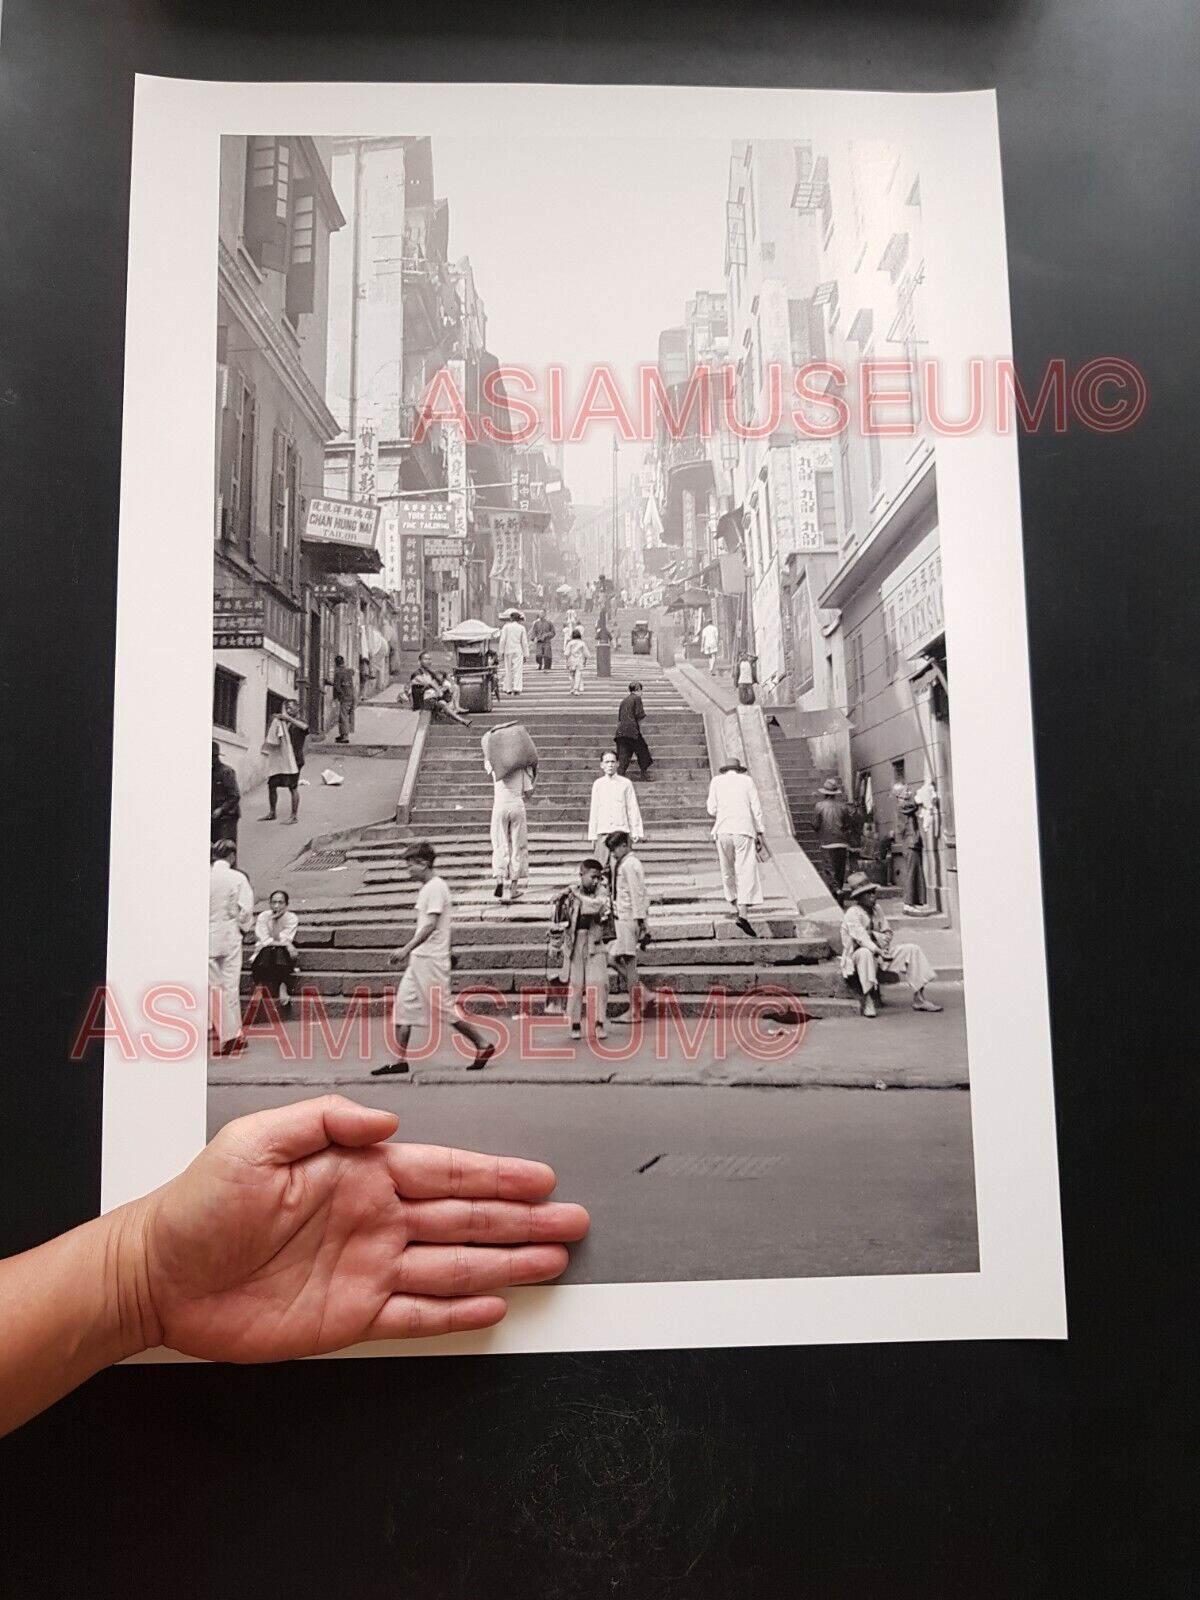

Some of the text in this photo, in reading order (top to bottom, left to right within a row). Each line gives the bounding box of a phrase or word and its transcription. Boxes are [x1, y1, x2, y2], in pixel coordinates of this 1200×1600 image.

[309, 514, 333, 527] CHAN
[334, 518, 357, 531] HUNG
[323, 529, 357, 541] TAILOR
